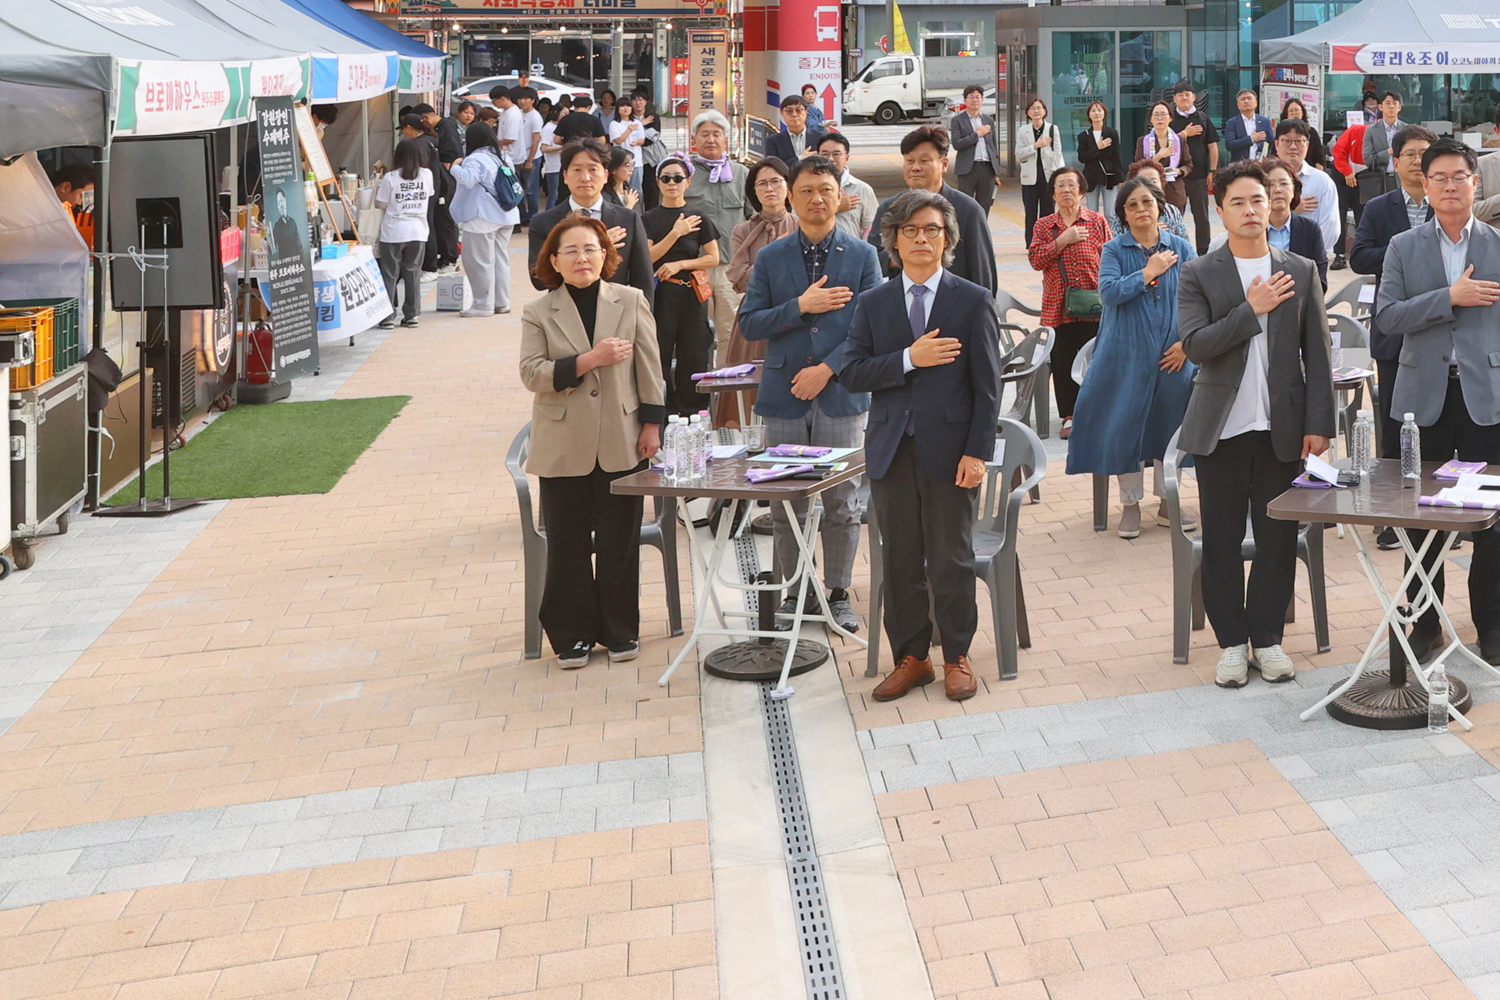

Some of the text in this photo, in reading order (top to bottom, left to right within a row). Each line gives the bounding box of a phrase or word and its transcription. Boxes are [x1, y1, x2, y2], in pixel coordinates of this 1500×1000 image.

[798, 56, 836, 69] 즐기는
[1371, 51, 1449, 66] 젤리&조이
[699, 47, 716, 110] 새로운 연결로
[144, 79, 201, 113] 브로이하우스
[261, 108, 289, 127] 강원장인
[262, 128, 290, 147] 수제맥주
[399, 181, 424, 192] 원주시
[395, 191, 427, 204] 탄소중립
[315, 305, 335, 323] 킹
